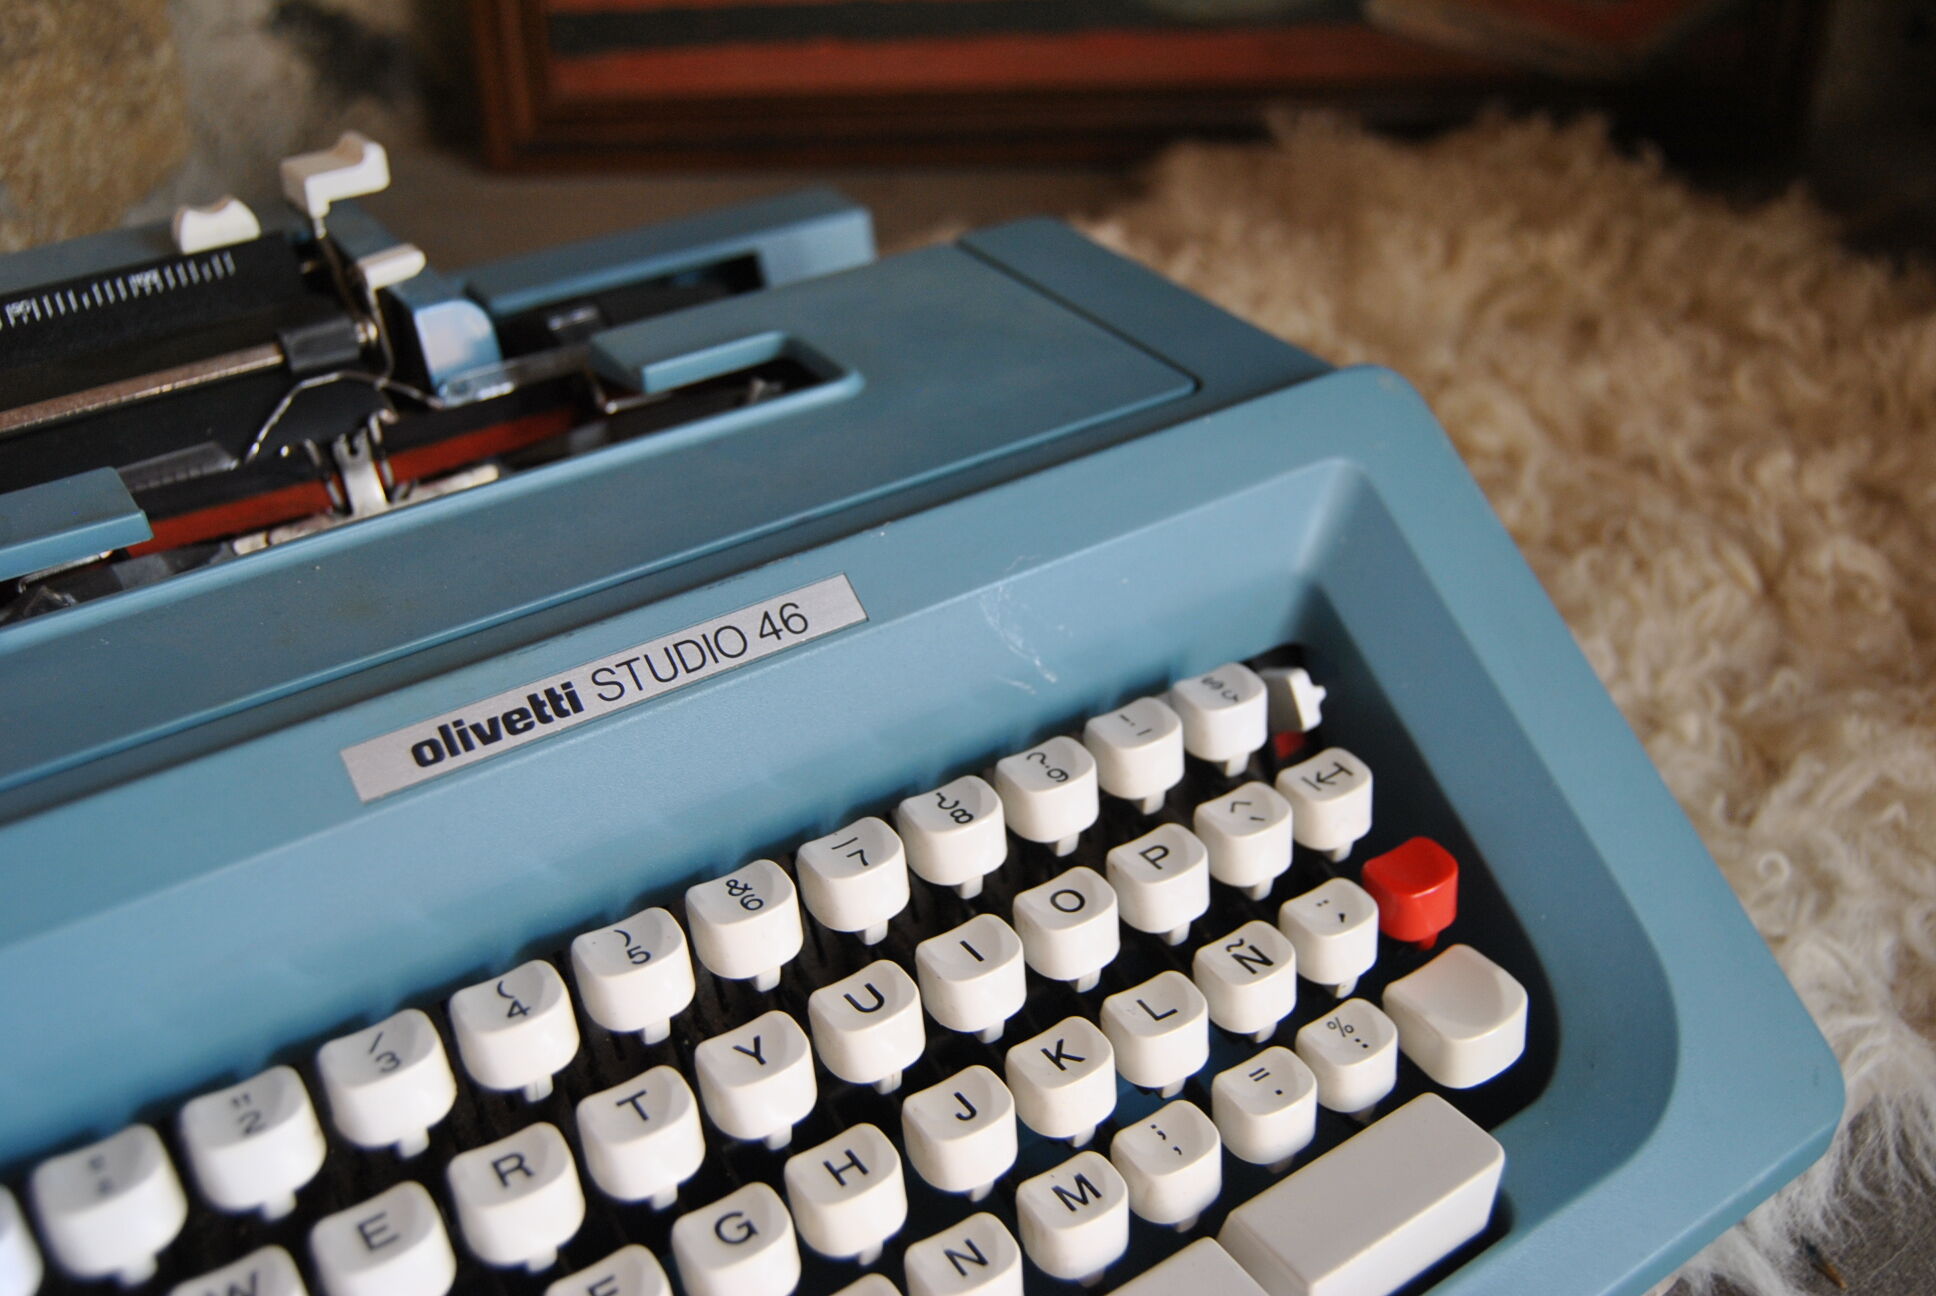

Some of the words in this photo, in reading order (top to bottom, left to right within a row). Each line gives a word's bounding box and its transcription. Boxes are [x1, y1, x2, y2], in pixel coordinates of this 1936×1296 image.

[411, 680, 585, 767] olivetti
[591, 625, 748, 702] STUDIO
[758, 602, 810, 643] 46
[1046, 768, 1070, 783] 9
[949, 807, 974, 825] 8
[847, 849, 869, 867] 7
[1140, 845, 1169, 869] P
[726, 877, 754, 898] &
[740, 893, 764, 911] 6
[1050, 889, 1086, 913] O
[627, 945, 652, 965] 5
[960, 940, 985, 962] I
[1225, 937, 1275, 975] Ñ
[506, 999, 531, 1019] 4
[844, 982, 885, 1014] U
[1137, 1000, 1178, 1021] L
[1326, 1016, 1355, 1038] %
[376, 1052, 400, 1072] 3
[734, 1036, 766, 1065] Y
[1041, 1039, 1085, 1071] K
[616, 1090, 650, 1123] T
[954, 1092, 976, 1121] J
[240, 1112, 261, 1134] 2
[492, 1154, 533, 1187] R
[824, 1150, 868, 1186] H
[1052, 1172, 1102, 1212] M
[356, 1212, 399, 1252] E
[715, 1212, 757, 1245] G
[945, 1240, 988, 1276] N
